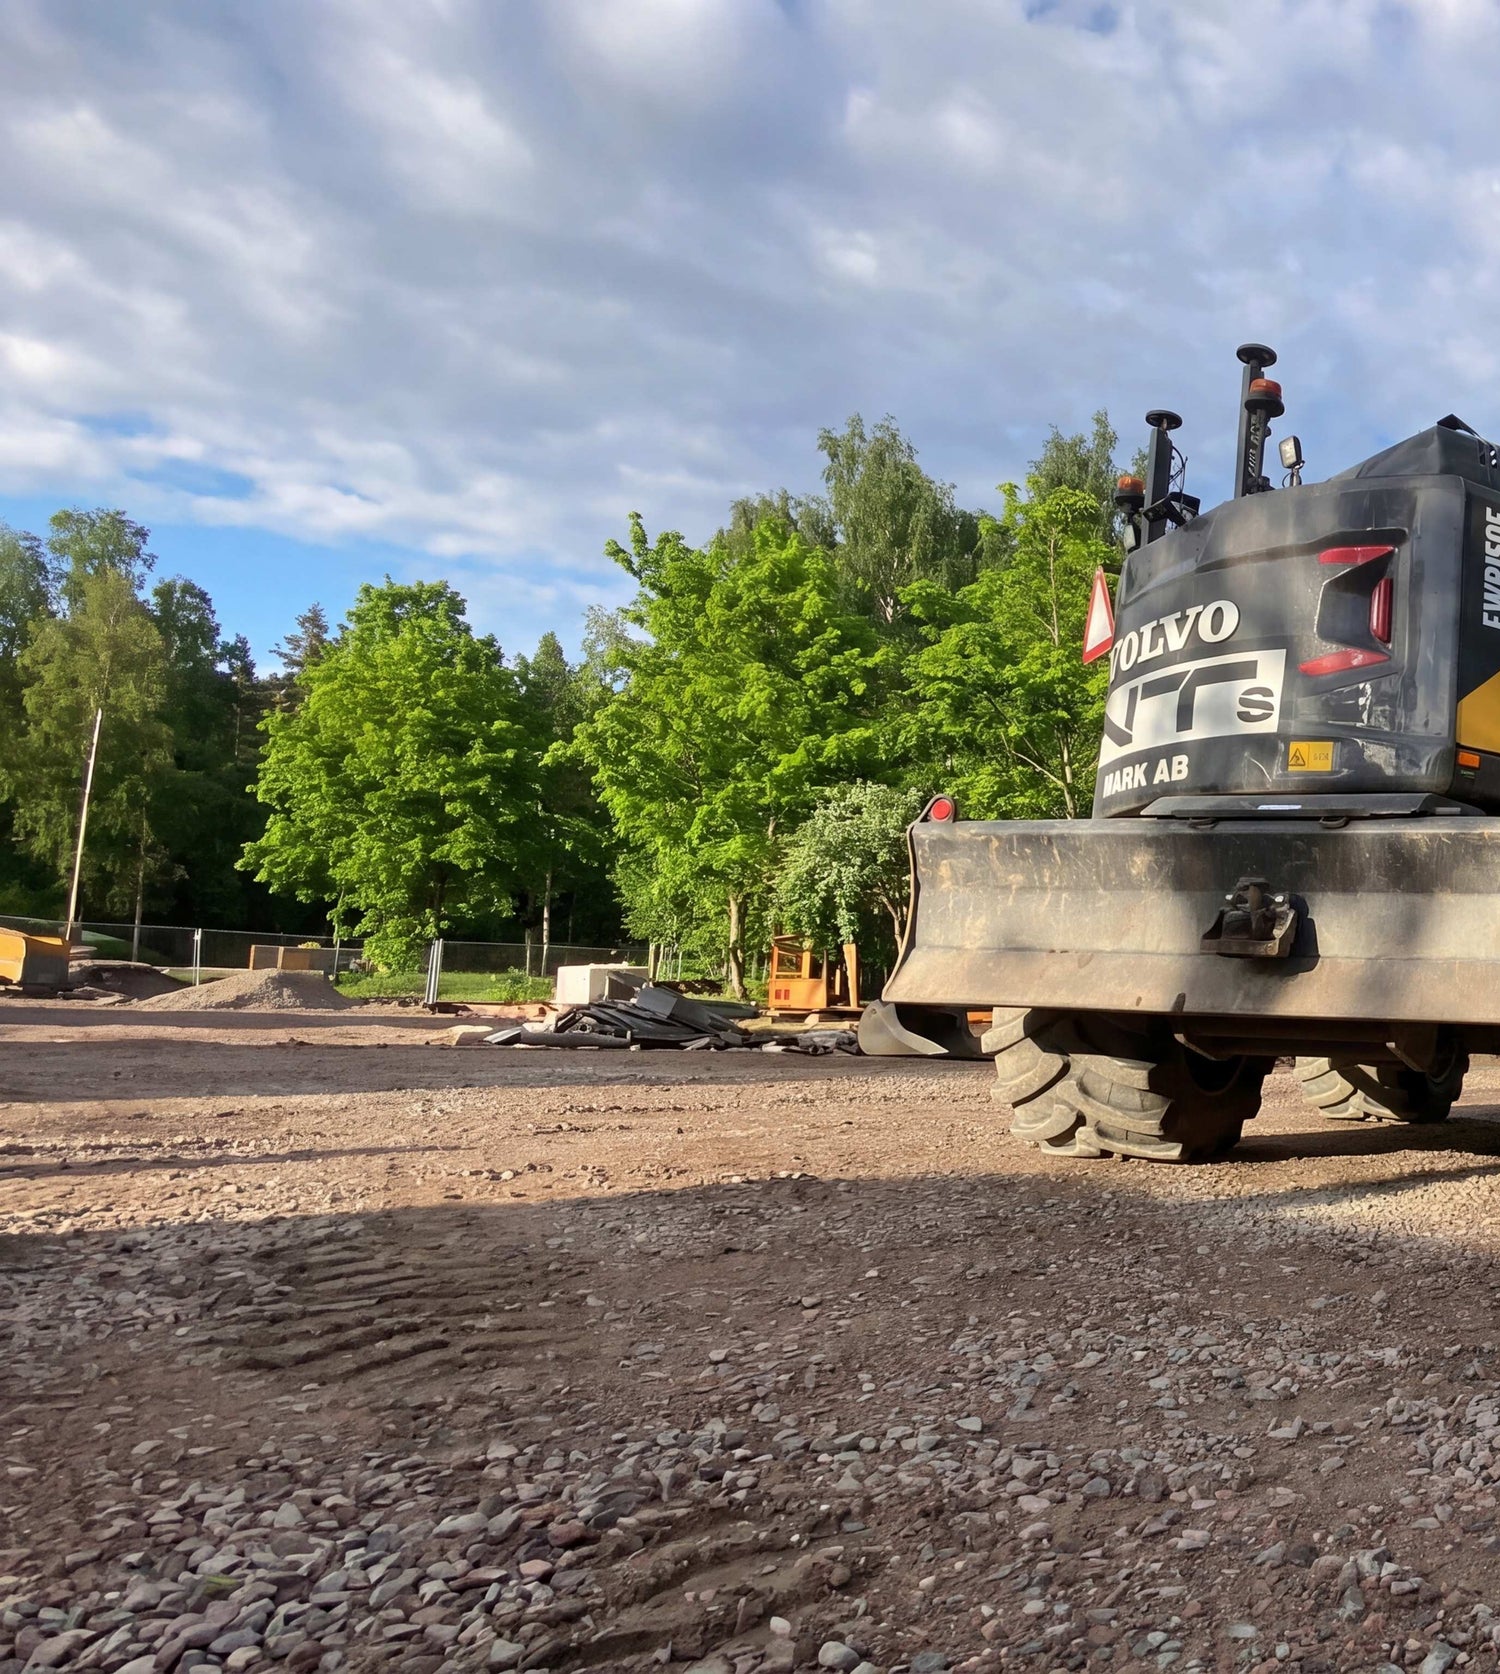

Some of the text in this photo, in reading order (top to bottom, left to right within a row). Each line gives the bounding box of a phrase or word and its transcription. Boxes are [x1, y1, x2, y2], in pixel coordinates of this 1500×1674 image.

[1109, 600, 1239, 684] VOLVO
[1102, 754, 1189, 799] MARK AB
